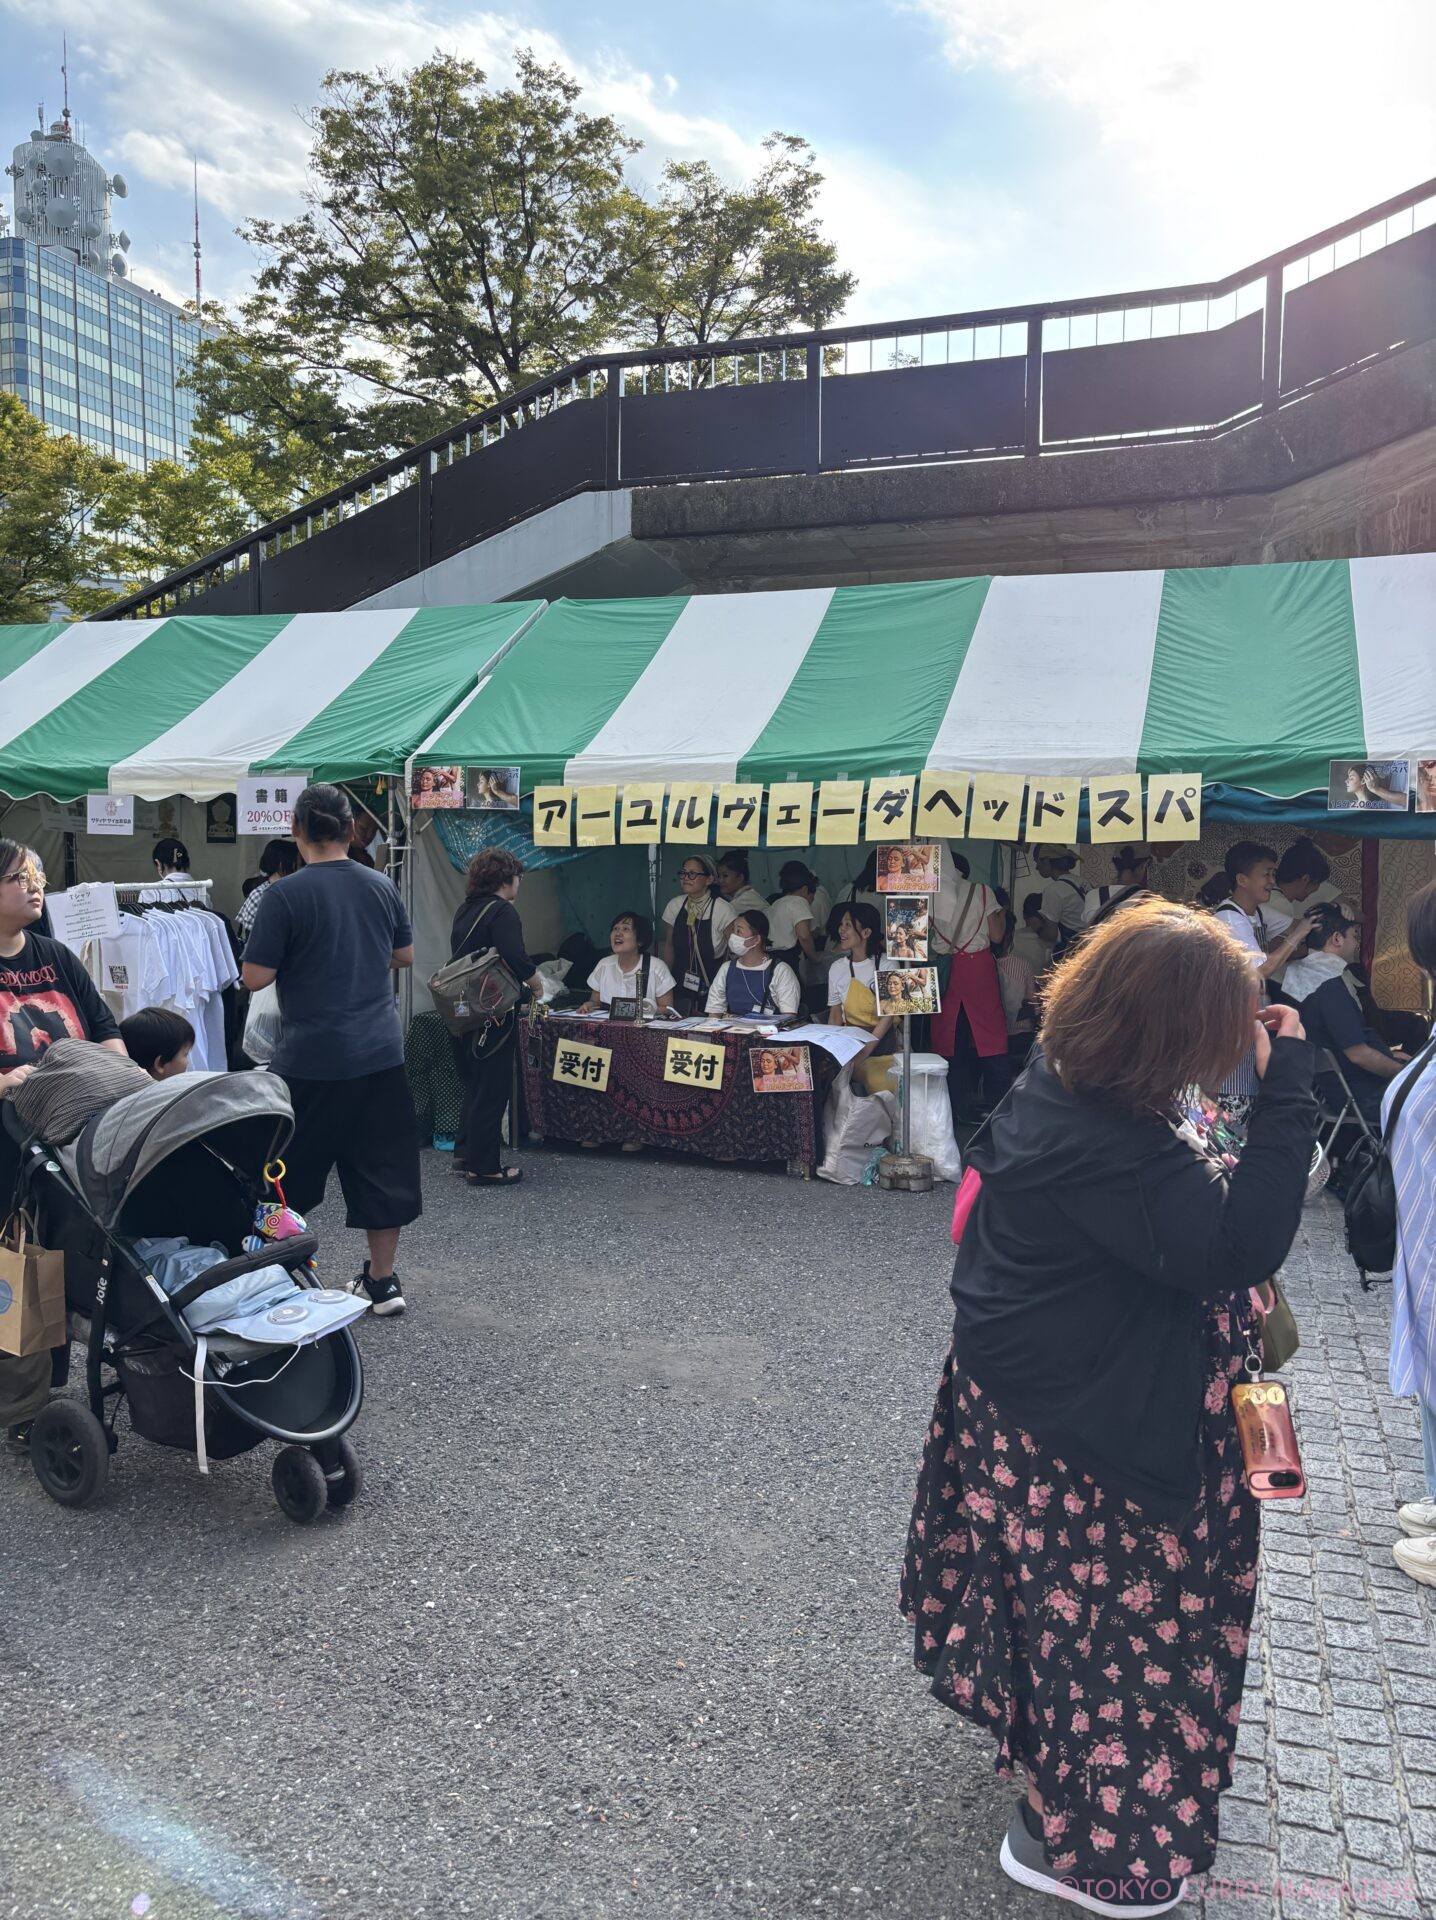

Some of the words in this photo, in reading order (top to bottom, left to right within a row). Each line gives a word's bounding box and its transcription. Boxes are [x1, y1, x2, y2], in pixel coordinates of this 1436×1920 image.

[255, 788, 288, 804] 書籍
[538, 787, 1197, 832] アーユルヴェーダヘッドスパ
[247, 810, 292, 823] 20%OF
[559, 1050, 605, 1083] 受付
[670, 1049, 719, 1081] 受付
